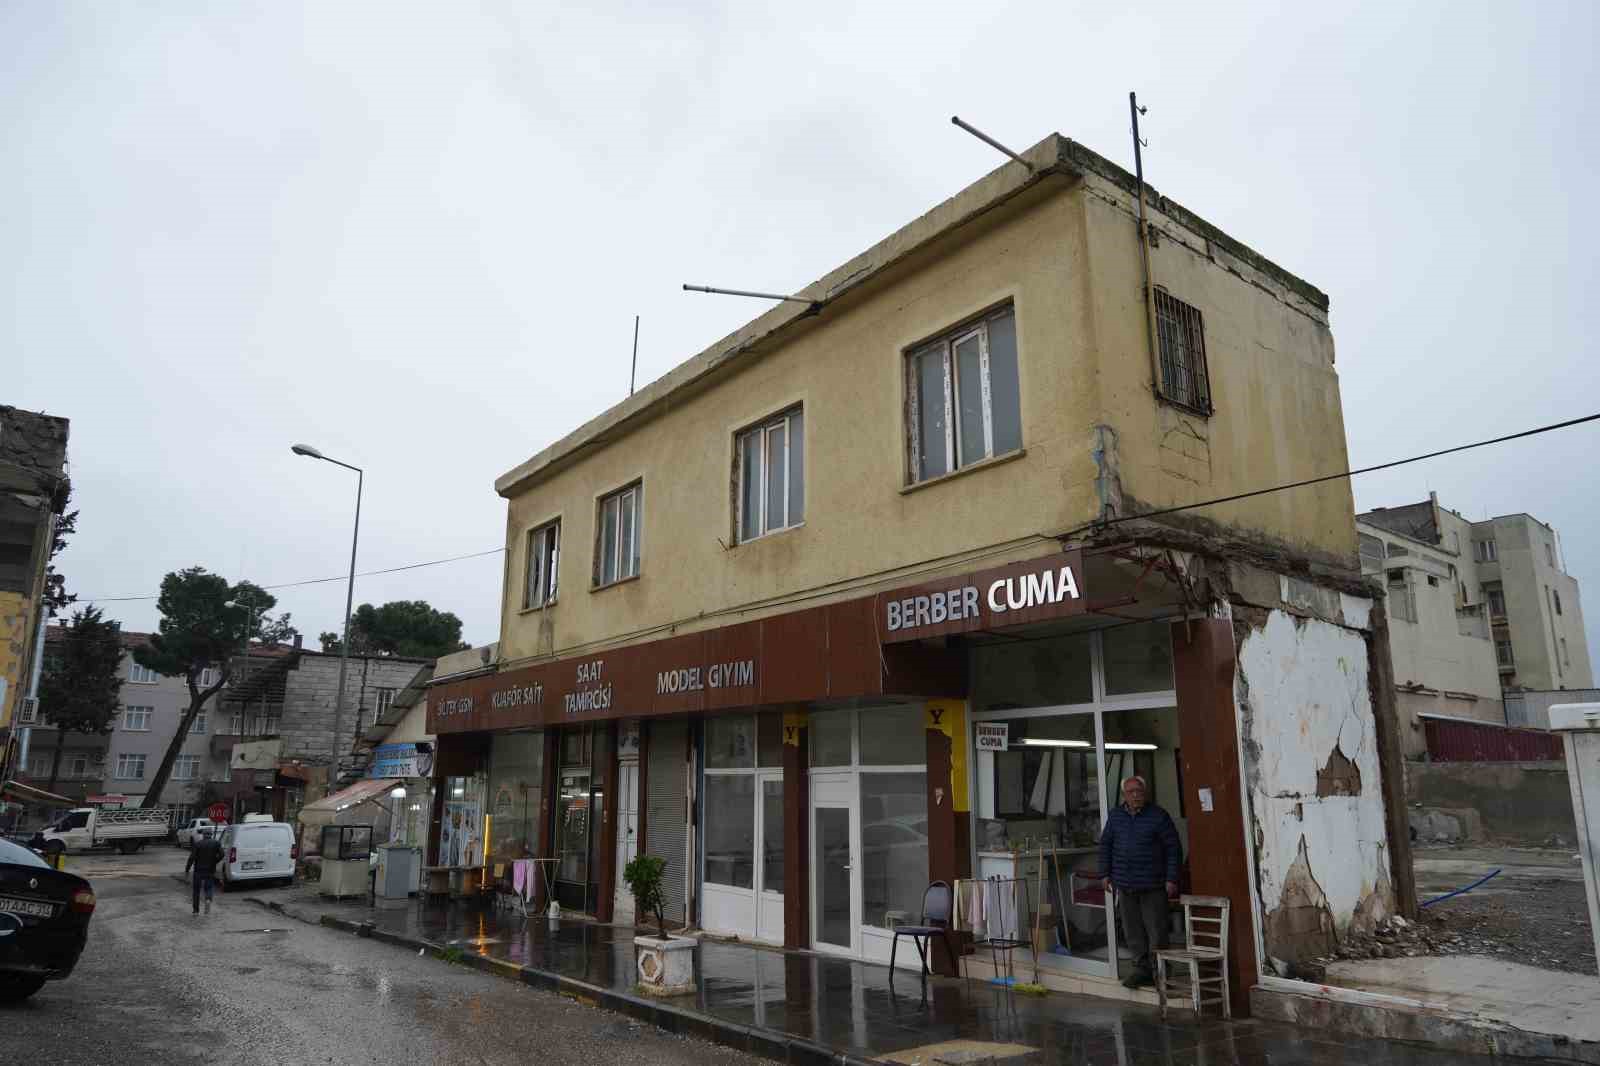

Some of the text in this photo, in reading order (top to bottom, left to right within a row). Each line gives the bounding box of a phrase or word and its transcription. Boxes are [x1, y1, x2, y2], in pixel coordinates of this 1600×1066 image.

[887, 566, 1080, 631] BERBER CUMA
[576, 660, 604, 683] SAAT
[657, 667, 704, 694] MODEL
[492, 684, 522, 709] KUAFÖR
[565, 681, 613, 713] TAMİRCİSİ
[980, 736, 1003, 747] CUMA
